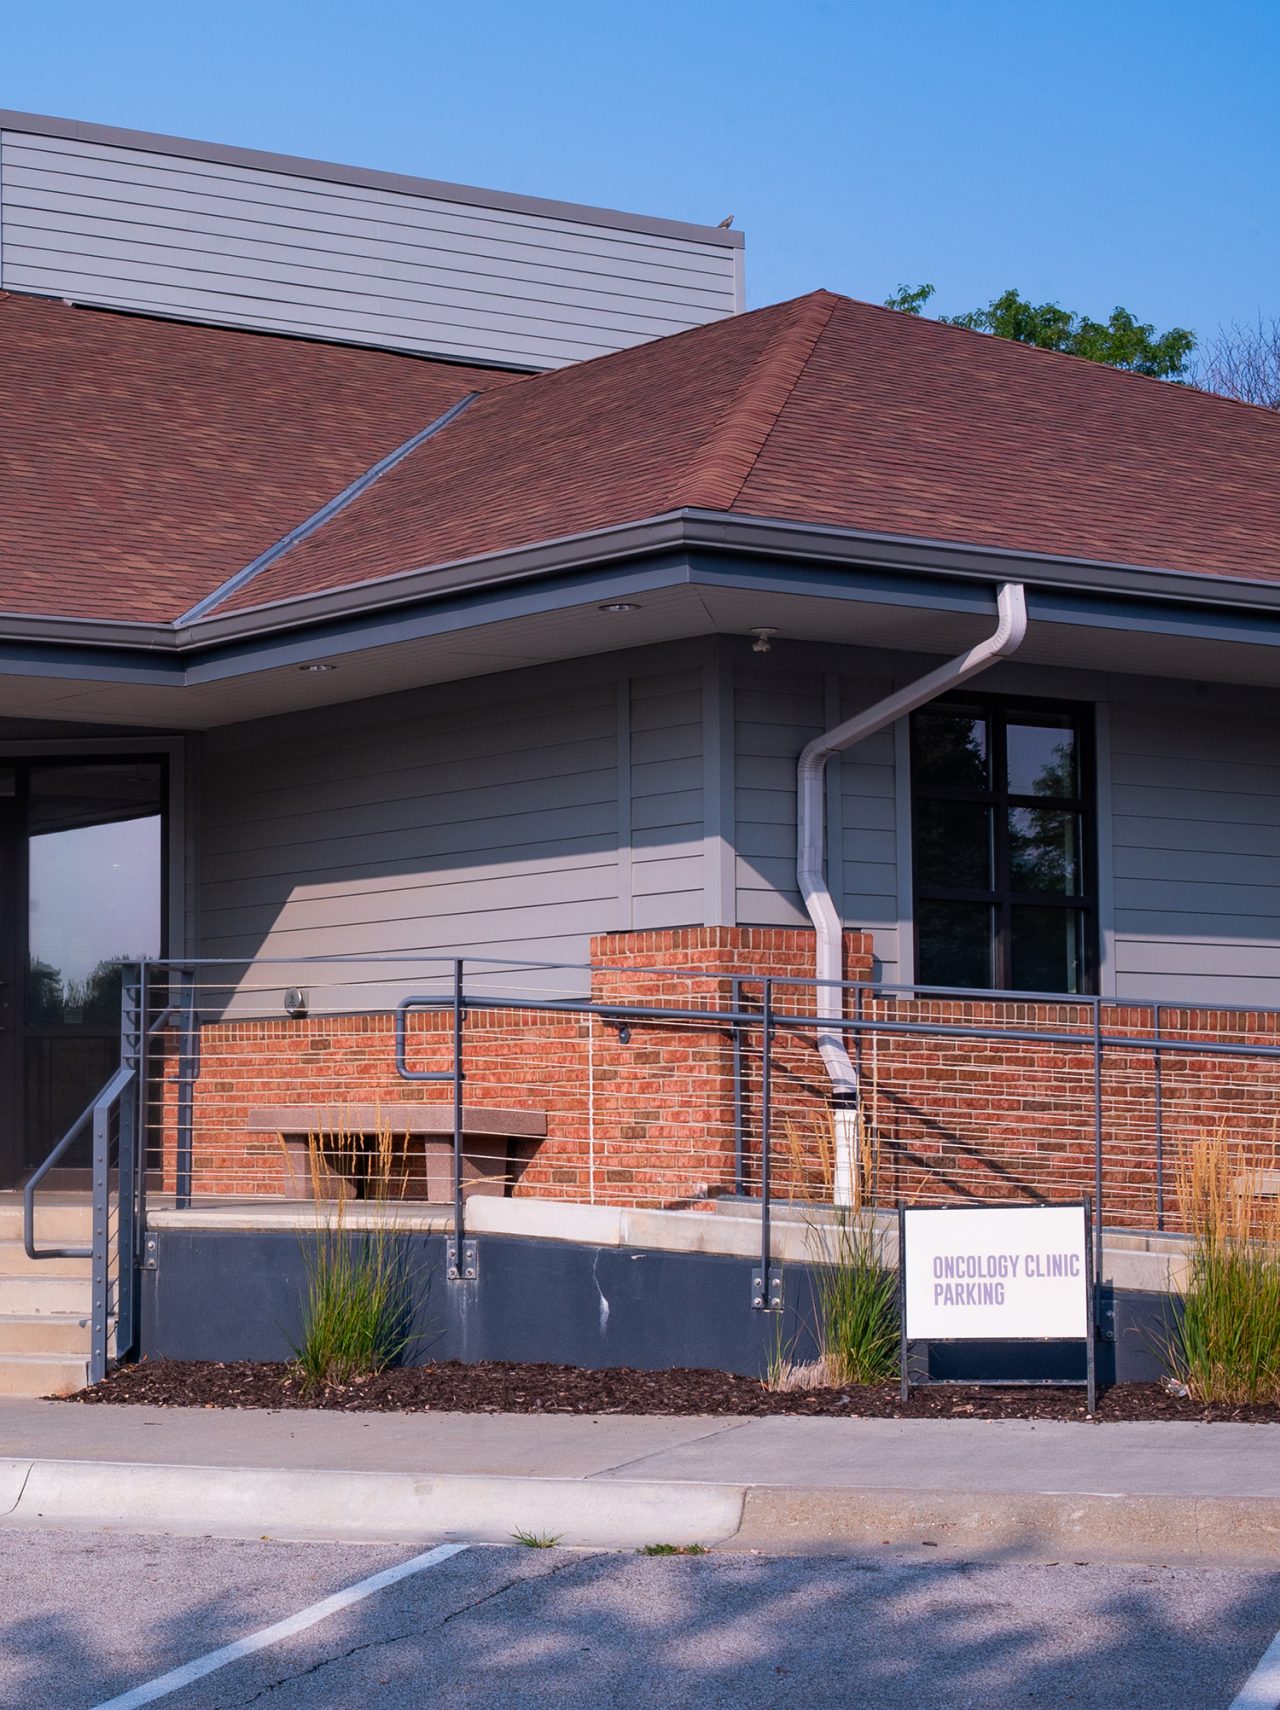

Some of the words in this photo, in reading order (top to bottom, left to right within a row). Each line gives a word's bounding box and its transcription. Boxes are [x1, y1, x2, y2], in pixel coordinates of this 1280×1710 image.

[933, 1255, 1020, 1279] ONCOLOGY
[1024, 1253, 1080, 1278] CLINIC
[934, 1282, 1005, 1306] PARKING
